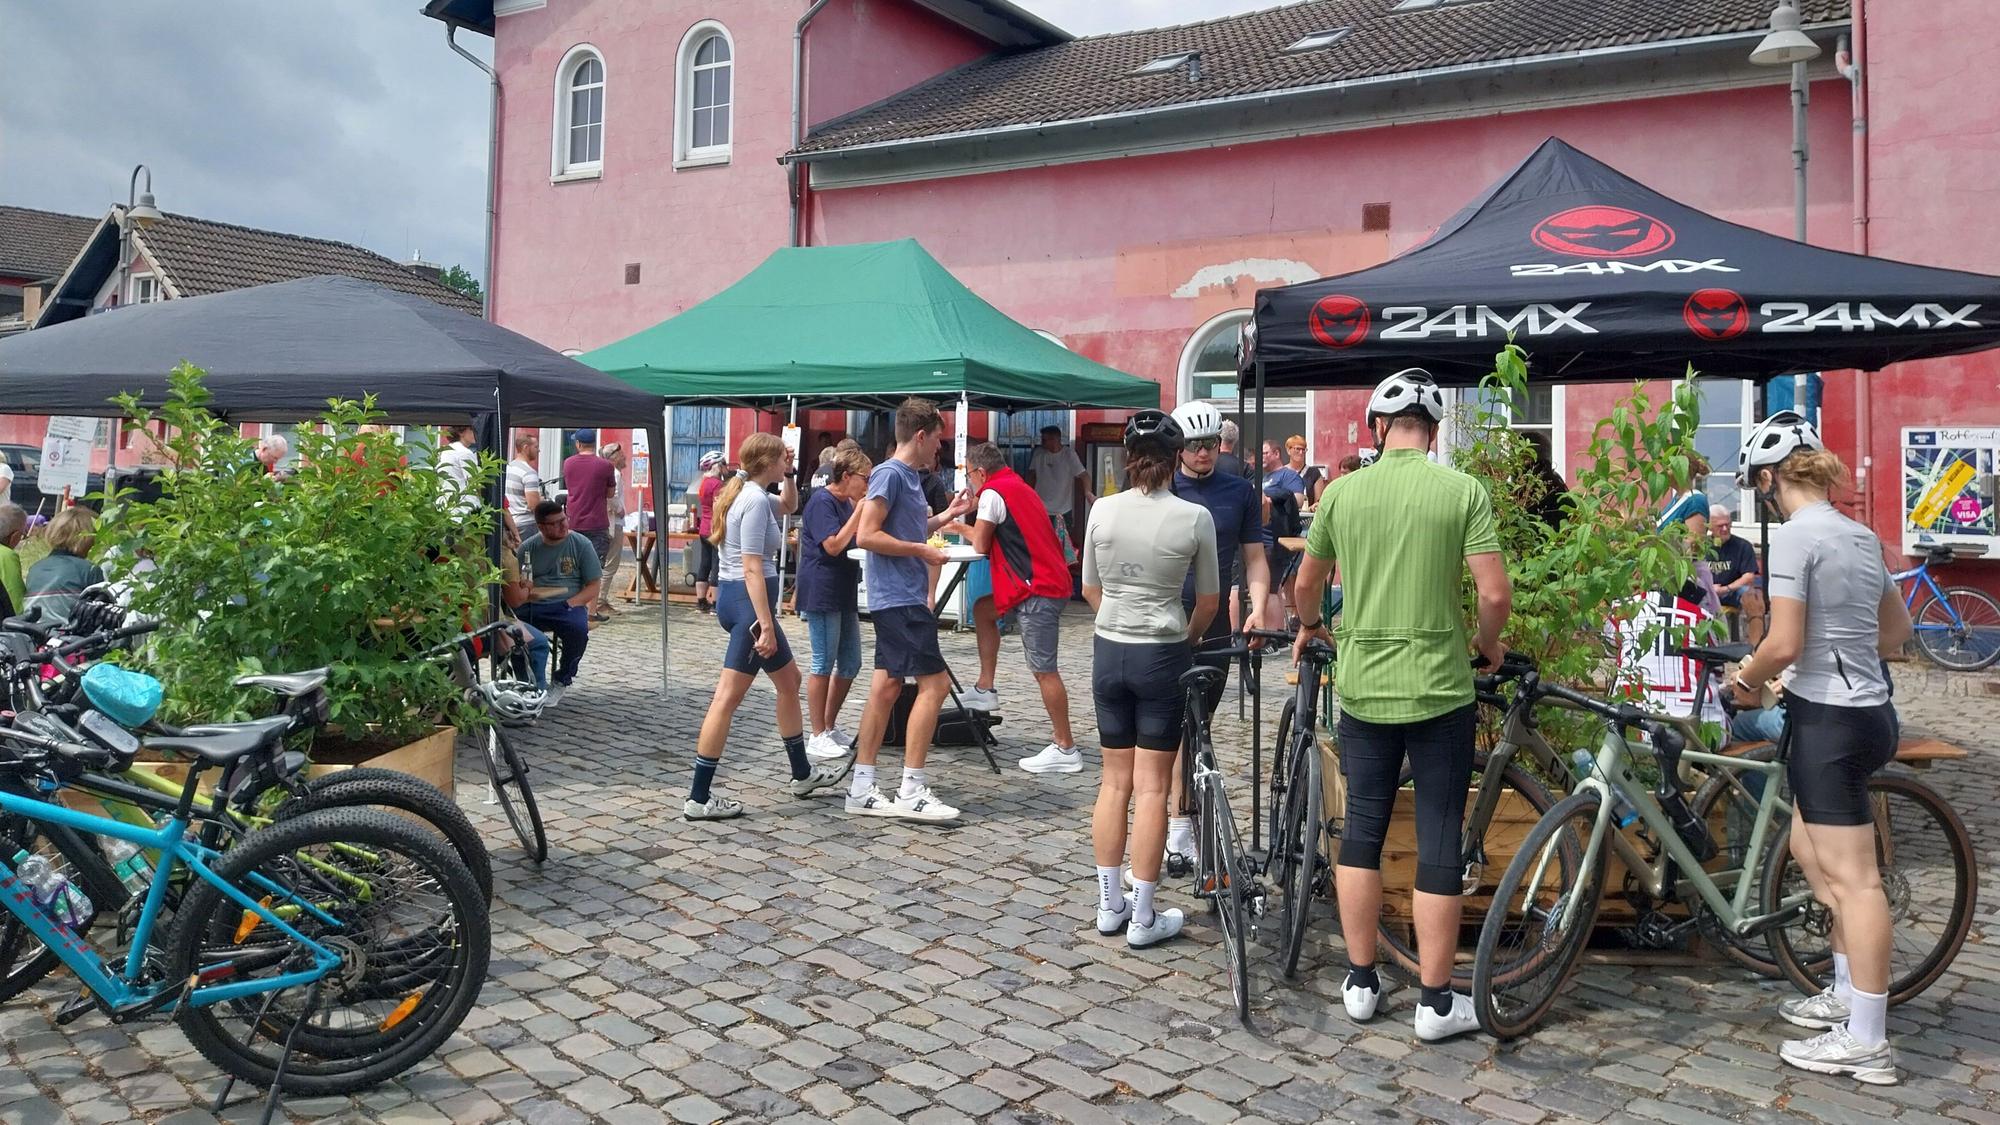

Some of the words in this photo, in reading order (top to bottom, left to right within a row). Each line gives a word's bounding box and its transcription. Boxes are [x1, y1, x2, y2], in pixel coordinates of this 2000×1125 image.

[1510, 259, 1740, 275] 24MX
[1380, 302, 1599, 339] 24MX
[1760, 302, 1982, 332] 24MX
[1957, 511, 1977, 519] VISA
